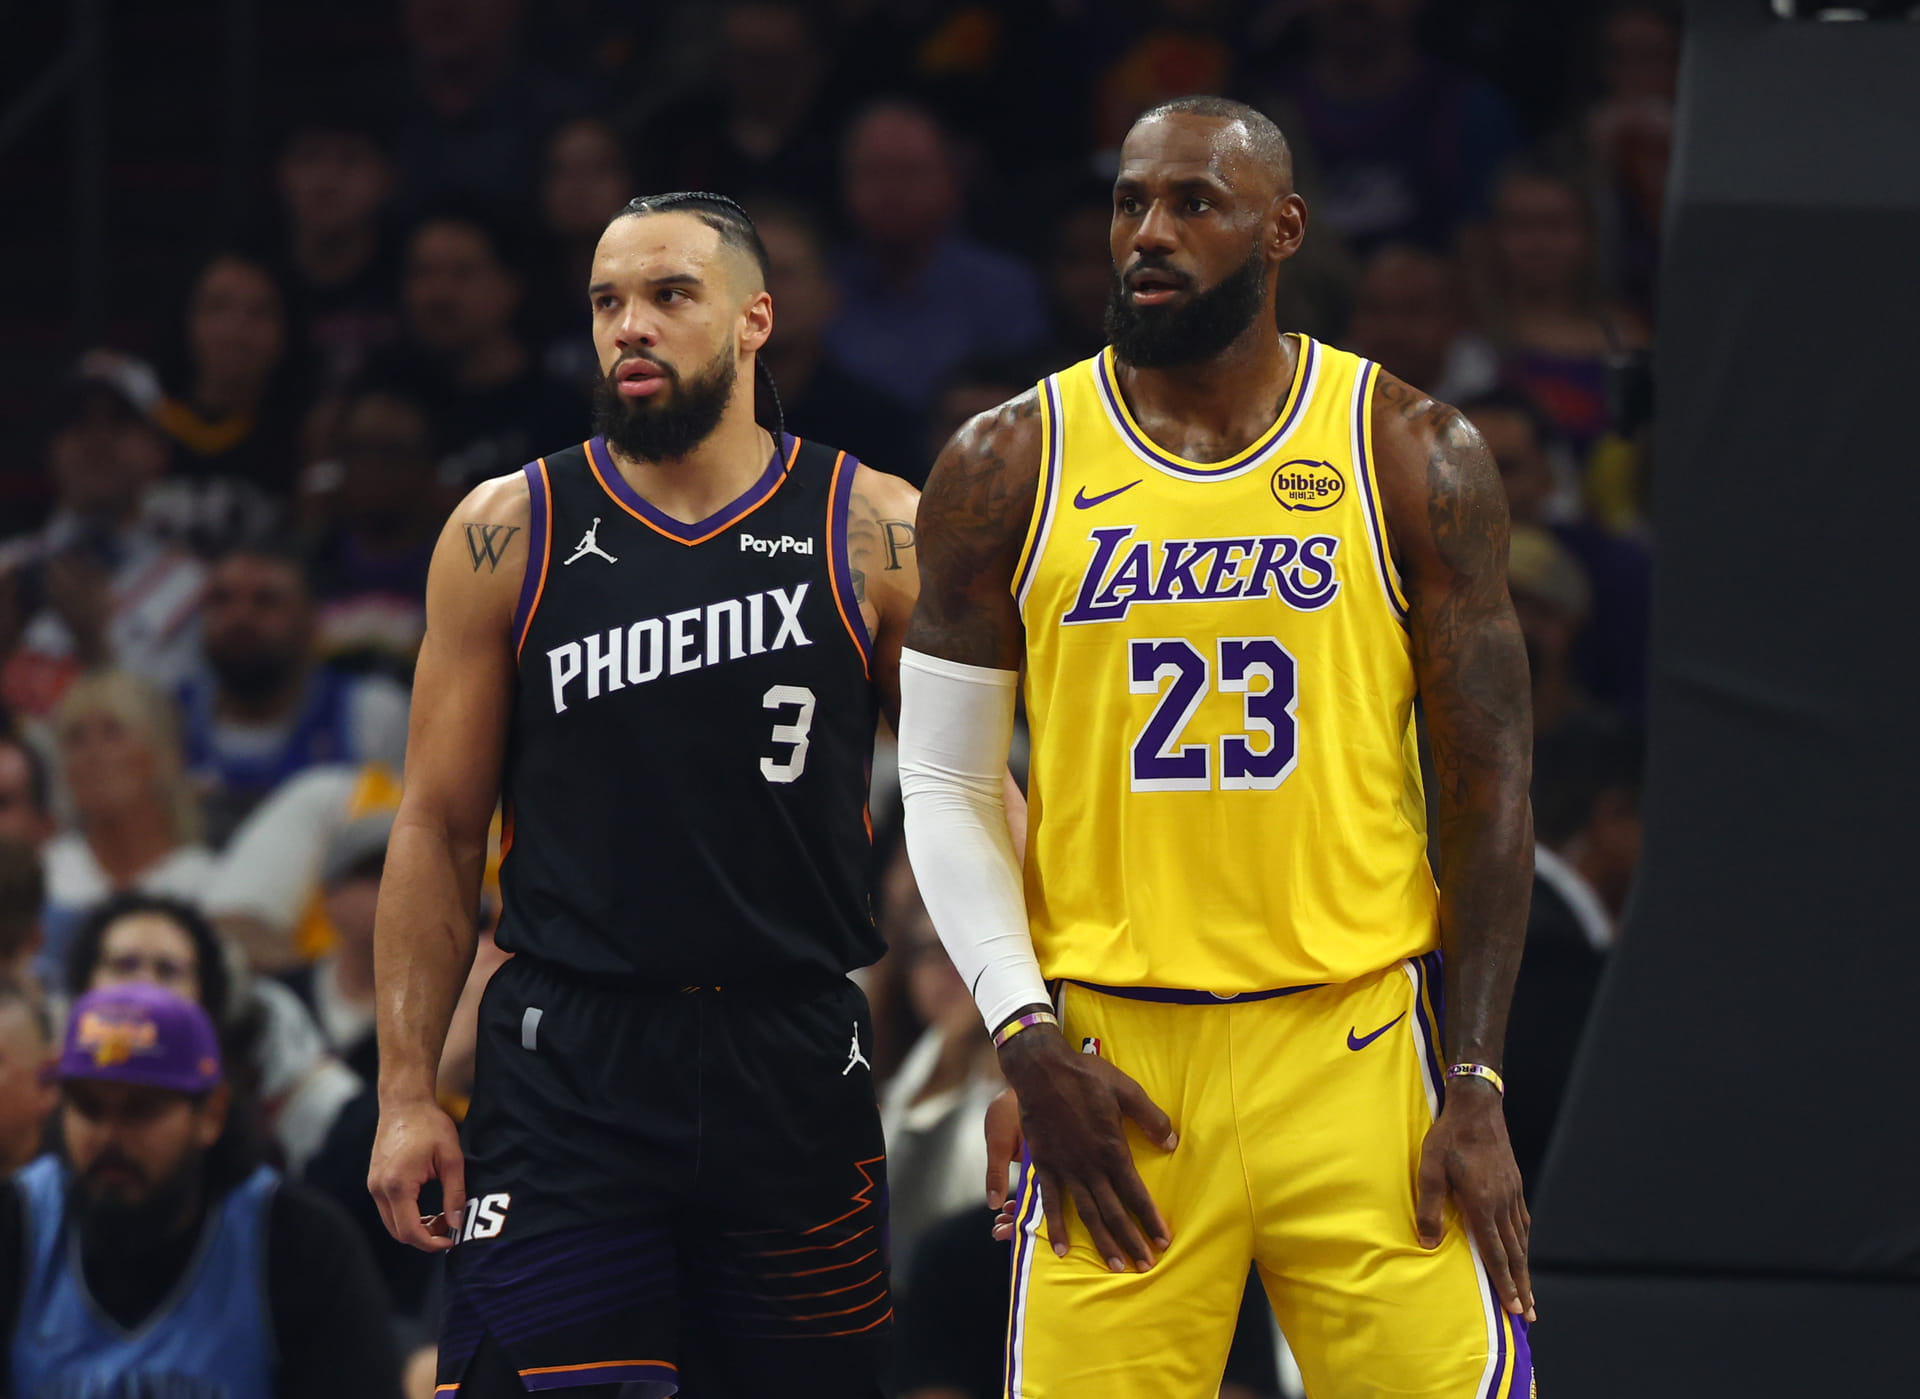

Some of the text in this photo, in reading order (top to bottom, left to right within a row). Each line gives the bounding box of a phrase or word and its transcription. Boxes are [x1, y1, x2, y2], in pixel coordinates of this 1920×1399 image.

[1278, 473, 1340, 496] bibigo
[1289, 491, 1315, 500] 비비고
[463, 523, 521, 574] W
[740, 533, 813, 557] PayPal
[1060, 525, 1341, 626] LAKERS
[546, 582, 813, 714] PHOENIX
[760, 685, 816, 783] 3
[1128, 636, 1299, 793] 23
